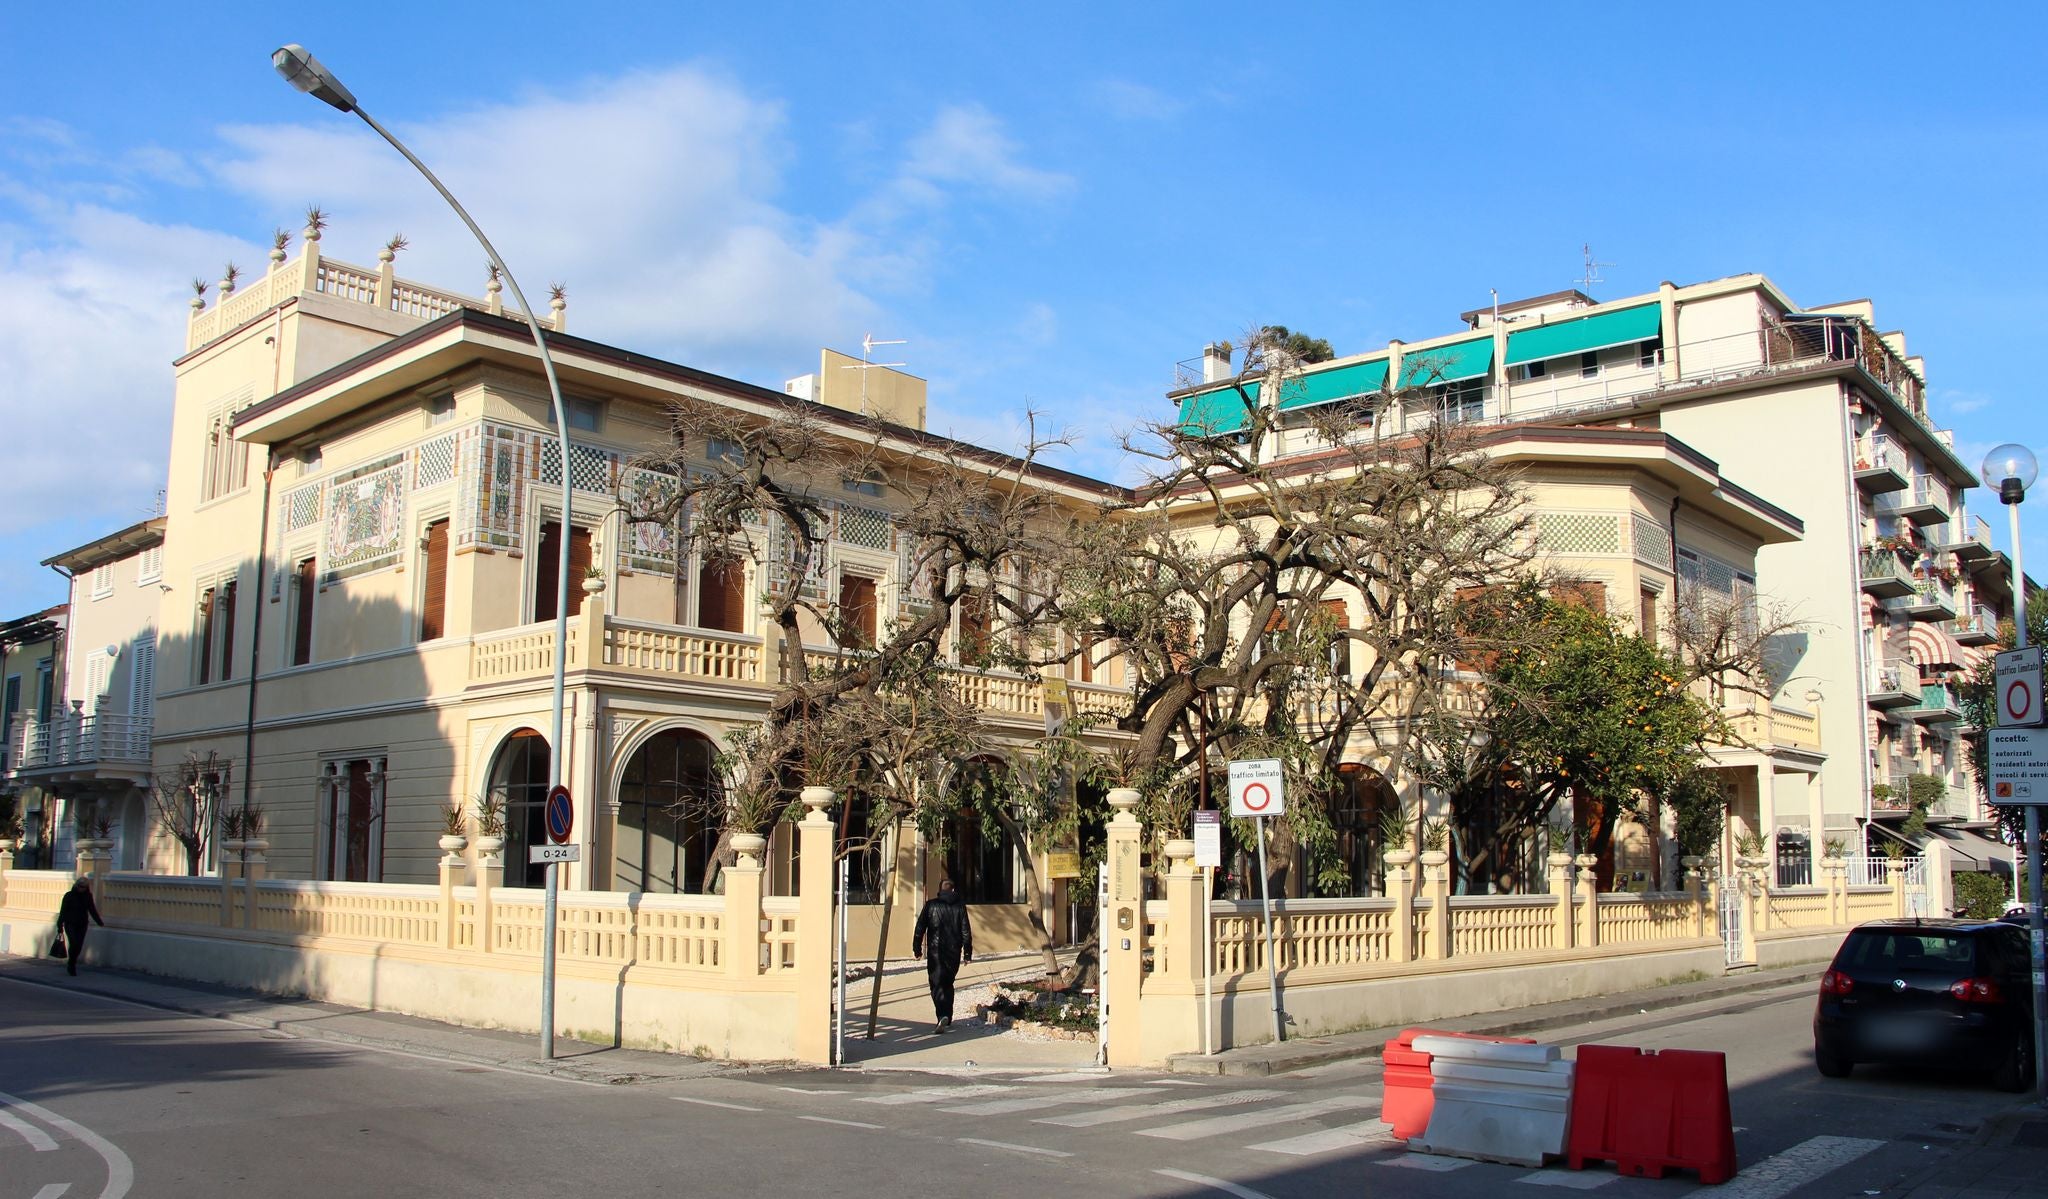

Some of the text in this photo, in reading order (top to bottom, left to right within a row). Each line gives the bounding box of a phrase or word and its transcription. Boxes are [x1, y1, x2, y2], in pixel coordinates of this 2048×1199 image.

[1997, 662, 2038, 676] traffico limitato
[1995, 735, 2028, 743] eccetto:
[543, 850, 568, 858] 0-24
